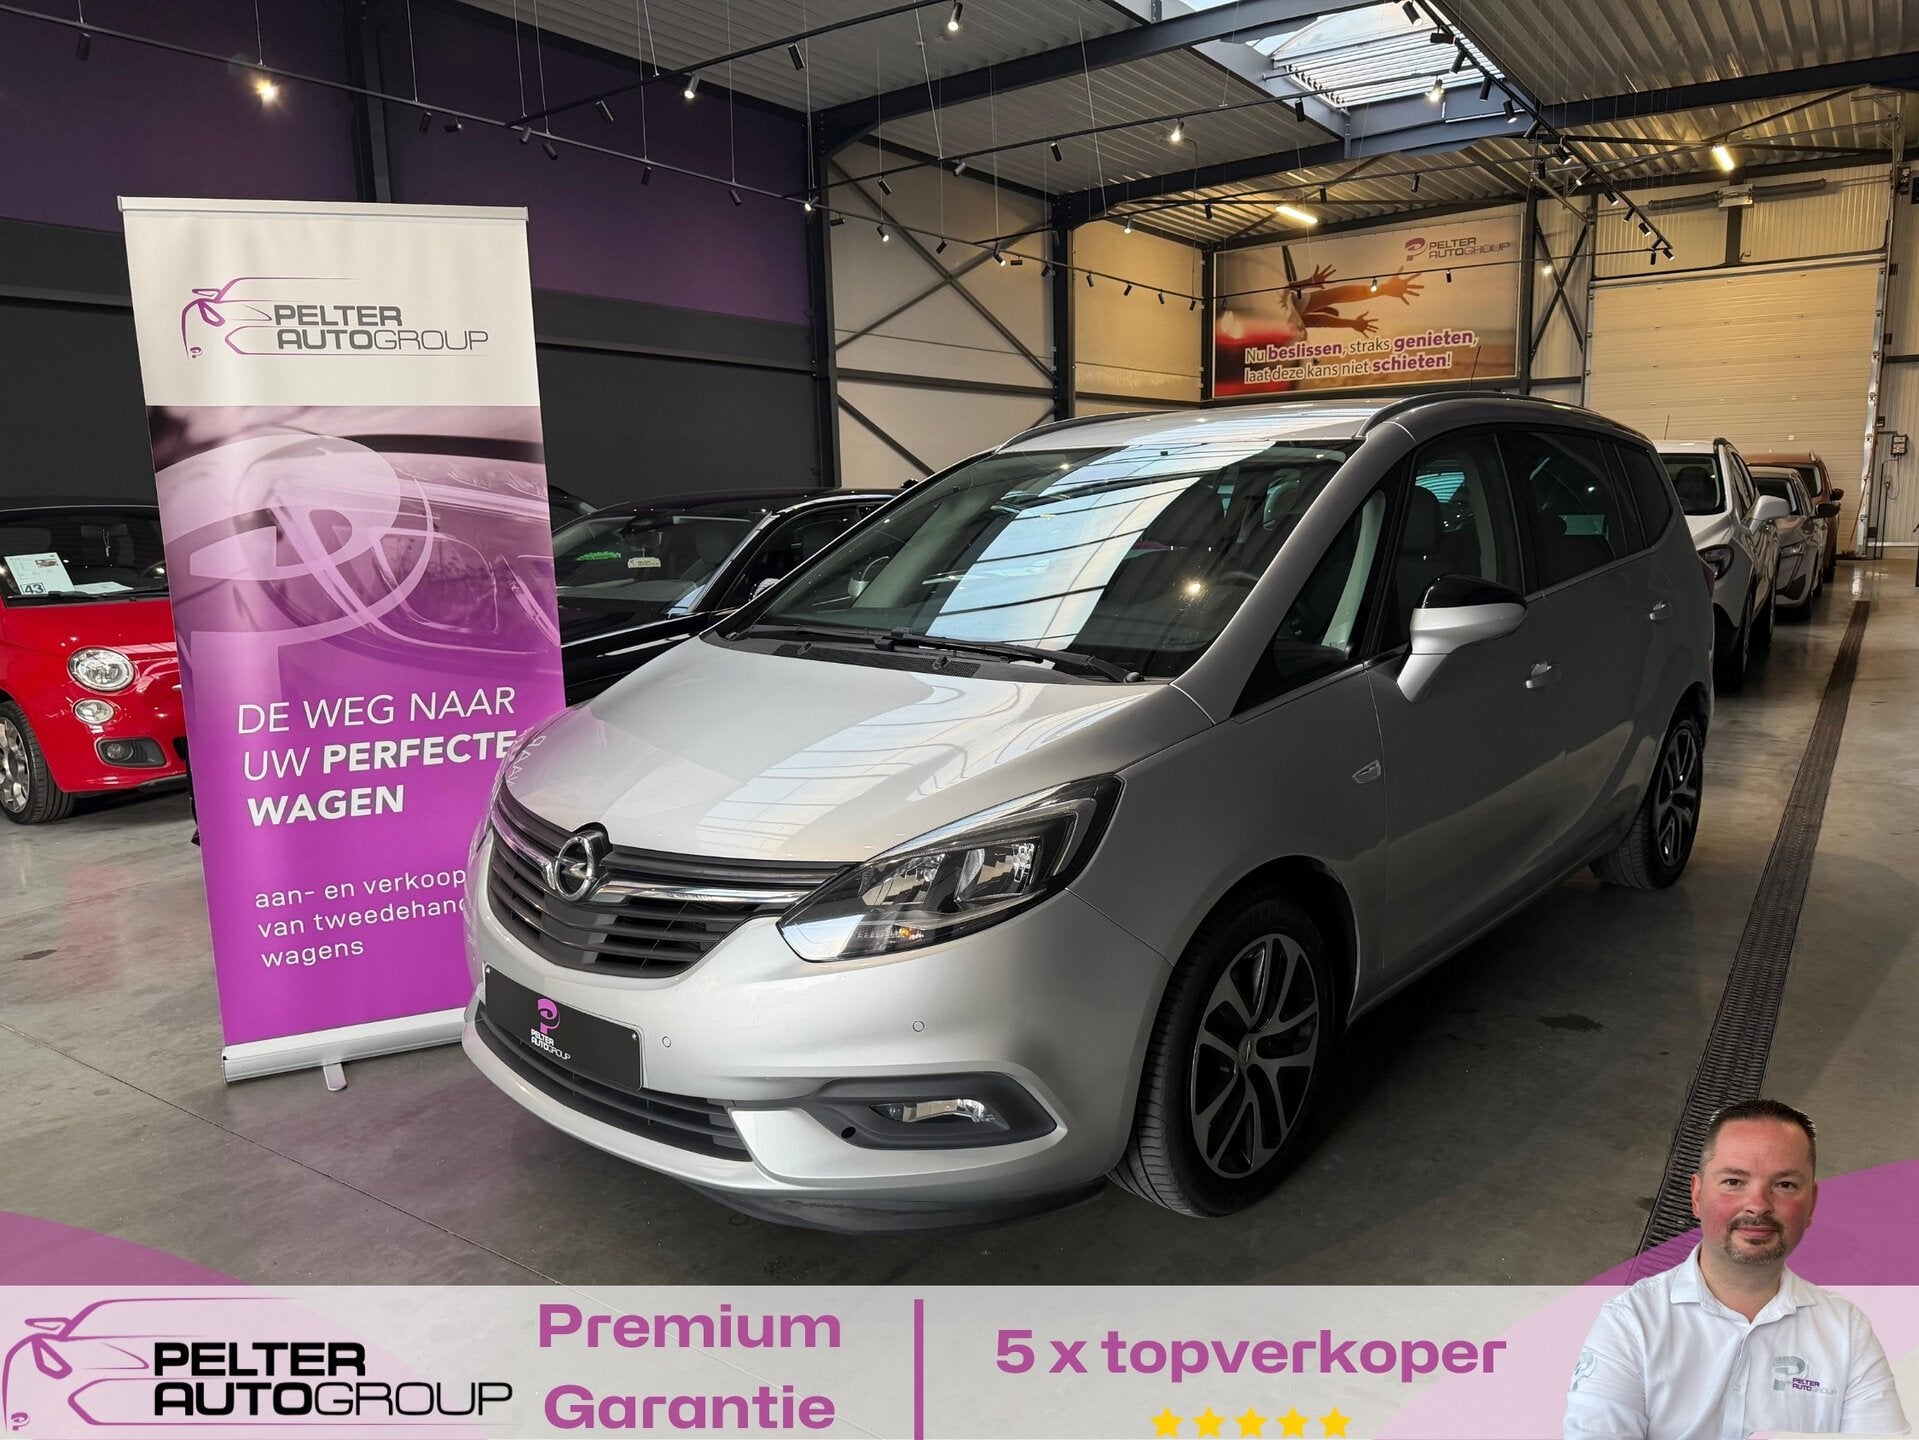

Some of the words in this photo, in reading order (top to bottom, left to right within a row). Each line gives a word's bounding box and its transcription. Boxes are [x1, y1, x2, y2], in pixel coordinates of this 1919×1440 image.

[1428, 241, 1511, 259] AUTOGROUP
[1429, 237, 1477, 250] PELTER
[274, 304, 403, 327] PELTER
[277, 329, 489, 351] AUTOGROUP
[1246, 348, 1264, 363] Nu
[1267, 342, 1346, 361] beslissen,
[1350, 337, 1390, 353] straks
[1393, 331, 1478, 352] genieten,
[1245, 368, 1271, 383] laat
[1272, 366, 1304, 381] deze
[1306, 363, 1338, 378] kans
[1342, 361, 1369, 375] niet
[1372, 353, 1452, 372] schieten!
[24, 583, 45, 594] 43
[237, 702, 290, 734] DE
[303, 694, 395, 729] WEG
[410, 686, 516, 721] NAAR
[244, 747, 311, 781] UW
[322, 730, 517, 774] PERFECTE
[247, 784, 404, 827] WAGEN
[255, 889, 315, 908] aan-
[324, 883, 355, 900] en
[363, 869, 466, 895] verkoop
[258, 919, 304, 938] van
[261, 937, 364, 968] wagens
[531, 1028, 555, 1046] PELTER
[531, 1036, 571, 1060] AUTOGROUP
[1792, 1378, 1820, 1387] PELTER
